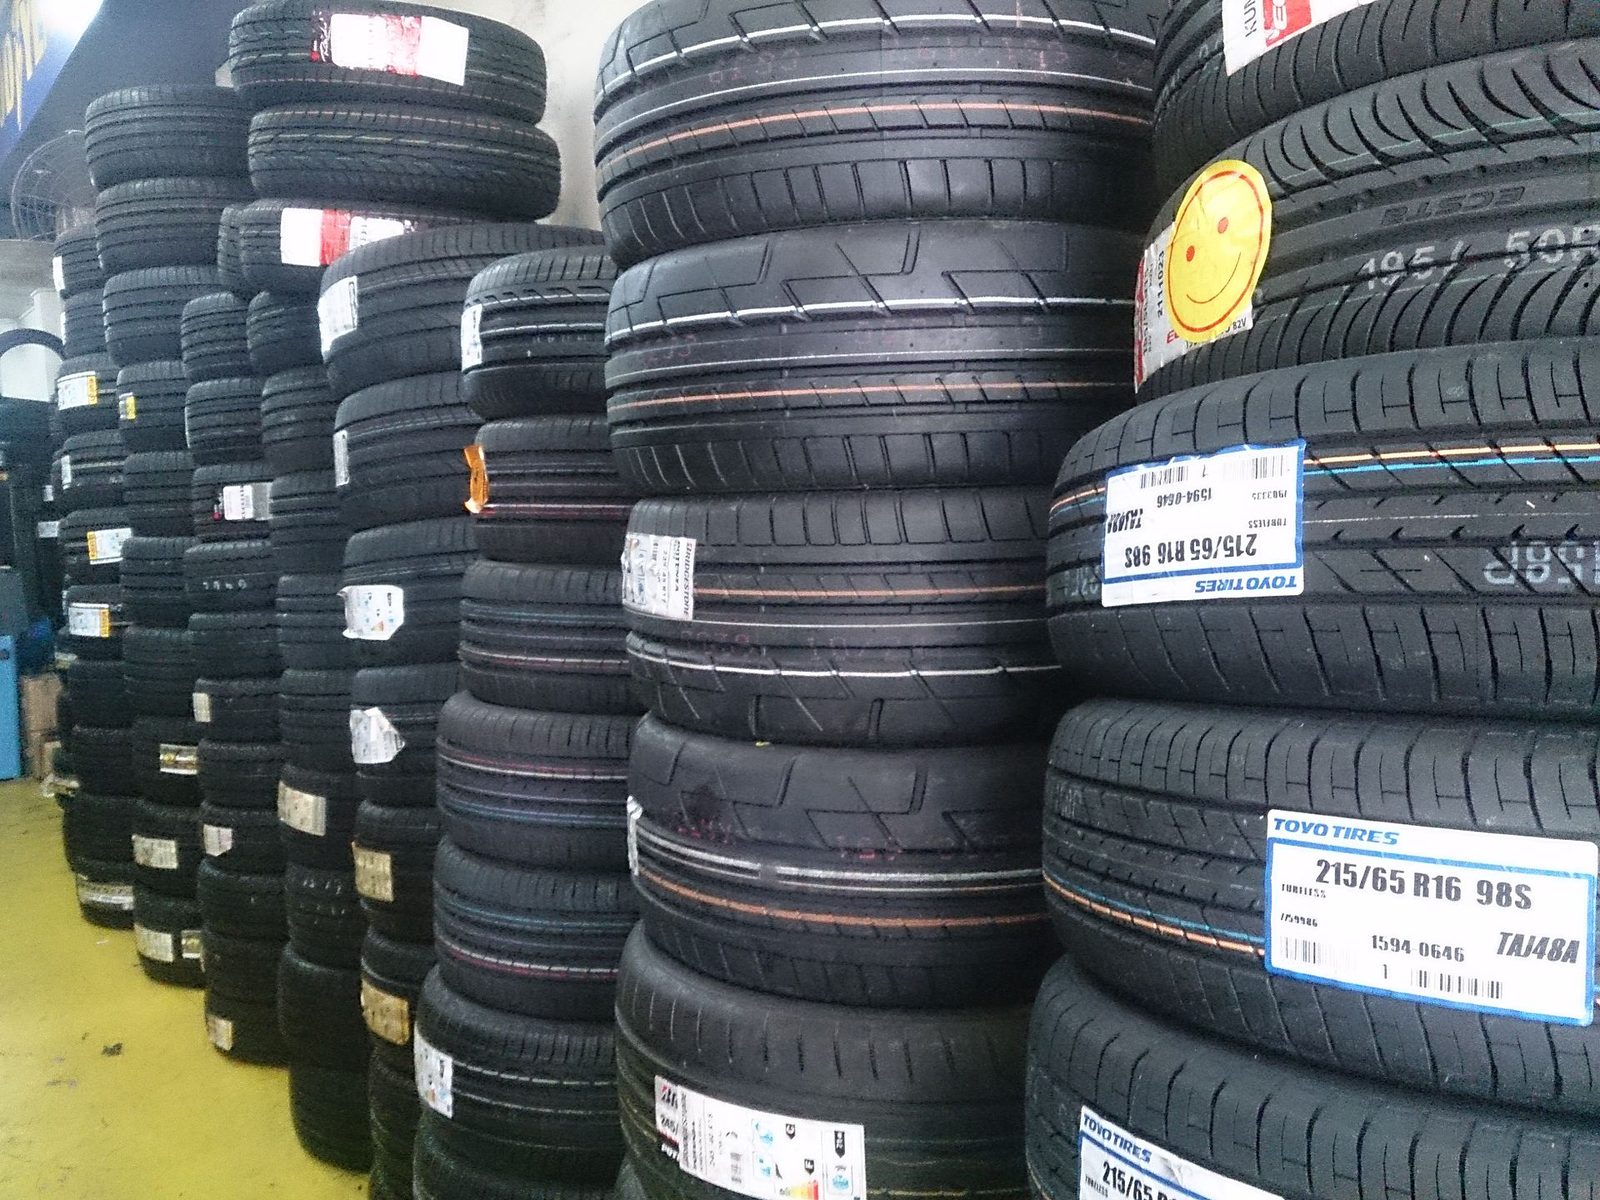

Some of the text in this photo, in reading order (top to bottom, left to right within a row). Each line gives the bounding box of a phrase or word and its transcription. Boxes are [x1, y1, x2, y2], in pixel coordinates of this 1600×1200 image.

[1156, 487, 1212, 508] 1594-0646
[1124, 533, 1258, 568] 215/65 R16 98S
[1194, 575, 1298, 593] TOYO TIRES
[1273, 817, 1400, 845] TOYO TIRES
[1314, 859, 1532, 910] 215/65 R16 98S
[1371, 931, 1580, 964] 1594-0646 TAJ48A
[1083, 1113, 1152, 1163] TOYO TIRES
[1102, 1160, 1154, 1200] 215/65
